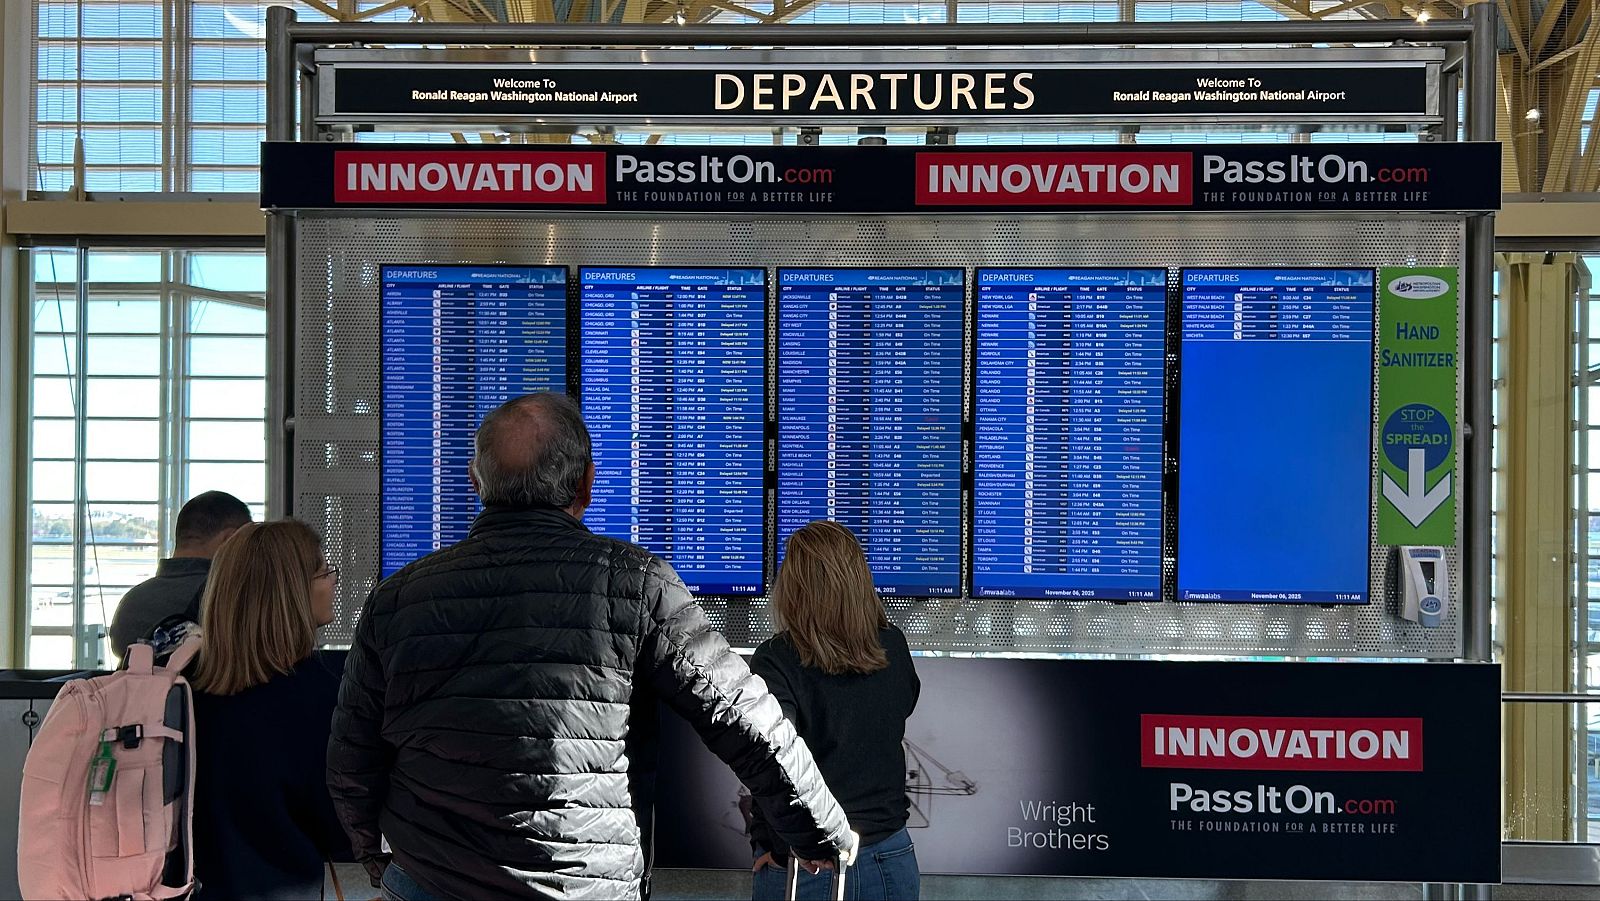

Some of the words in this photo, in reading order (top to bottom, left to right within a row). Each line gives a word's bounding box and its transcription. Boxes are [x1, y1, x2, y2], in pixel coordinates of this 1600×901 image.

[494, 79, 540, 88] Welcome
[543, 79, 556, 88] To
[1197, 78, 1245, 87] Welcome
[1248, 78, 1261, 87] To
[412, 90, 447, 100] Ronald
[450, 91, 488, 102] Reagan
[490, 91, 552, 103] Washington
[555, 92, 597, 101] National
[600, 92, 637, 103] Airport
[714, 73, 1034, 110] DEPARTURES
[1114, 91, 1149, 100] Ronald
[1153, 92, 1191, 102] Reagan
[1194, 91, 1257, 102] Washington
[1260, 90, 1304, 100] National
[1307, 91, 1345, 101] Airport
[348, 163, 592, 191] INNOVATION
[929, 164, 1178, 193] INNOVATION
[617, 192, 637, 201] THE
[645, 192, 720, 201] FOUNDATION
[728, 192, 744, 201] FOR
[751, 192, 757, 202] A
[763, 192, 803, 202] BETTER
[810, 192, 832, 202] LIFE
[1204, 192, 1224, 202] THE
[1233, 192, 1311, 201] FOUNDATION
[1319, 192, 1336, 201] FOR
[1342, 192, 1348, 201] A
[1356, 192, 1396, 201] BETTER
[1404, 192, 1427, 201] LIFE
[386, 270, 438, 278] DEPARTURES
[585, 272, 636, 280] DEPARTURES
[783, 274, 834, 282] DEPARTURES
[982, 274, 1034, 282] DEPARTURES
[1396, 322, 1439, 340] HAND
[1382, 349, 1453, 367] SANITIZER
[1401, 410, 1434, 420] STOP
[1387, 434, 1448, 445] SPREAD!
[1155, 728, 1408, 758] INNOVATION
[1020, 800, 1096, 826] Wright
[1171, 820, 1191, 830] THE
[1200, 821, 1278, 832] FOUNDATION
[1286, 823, 1303, 832] FOR
[1310, 823, 1316, 832] A
[1323, 823, 1364, 833] BETTER
[1372, 824, 1394, 833] LIFE
[1007, 827, 1109, 850] Brothers
